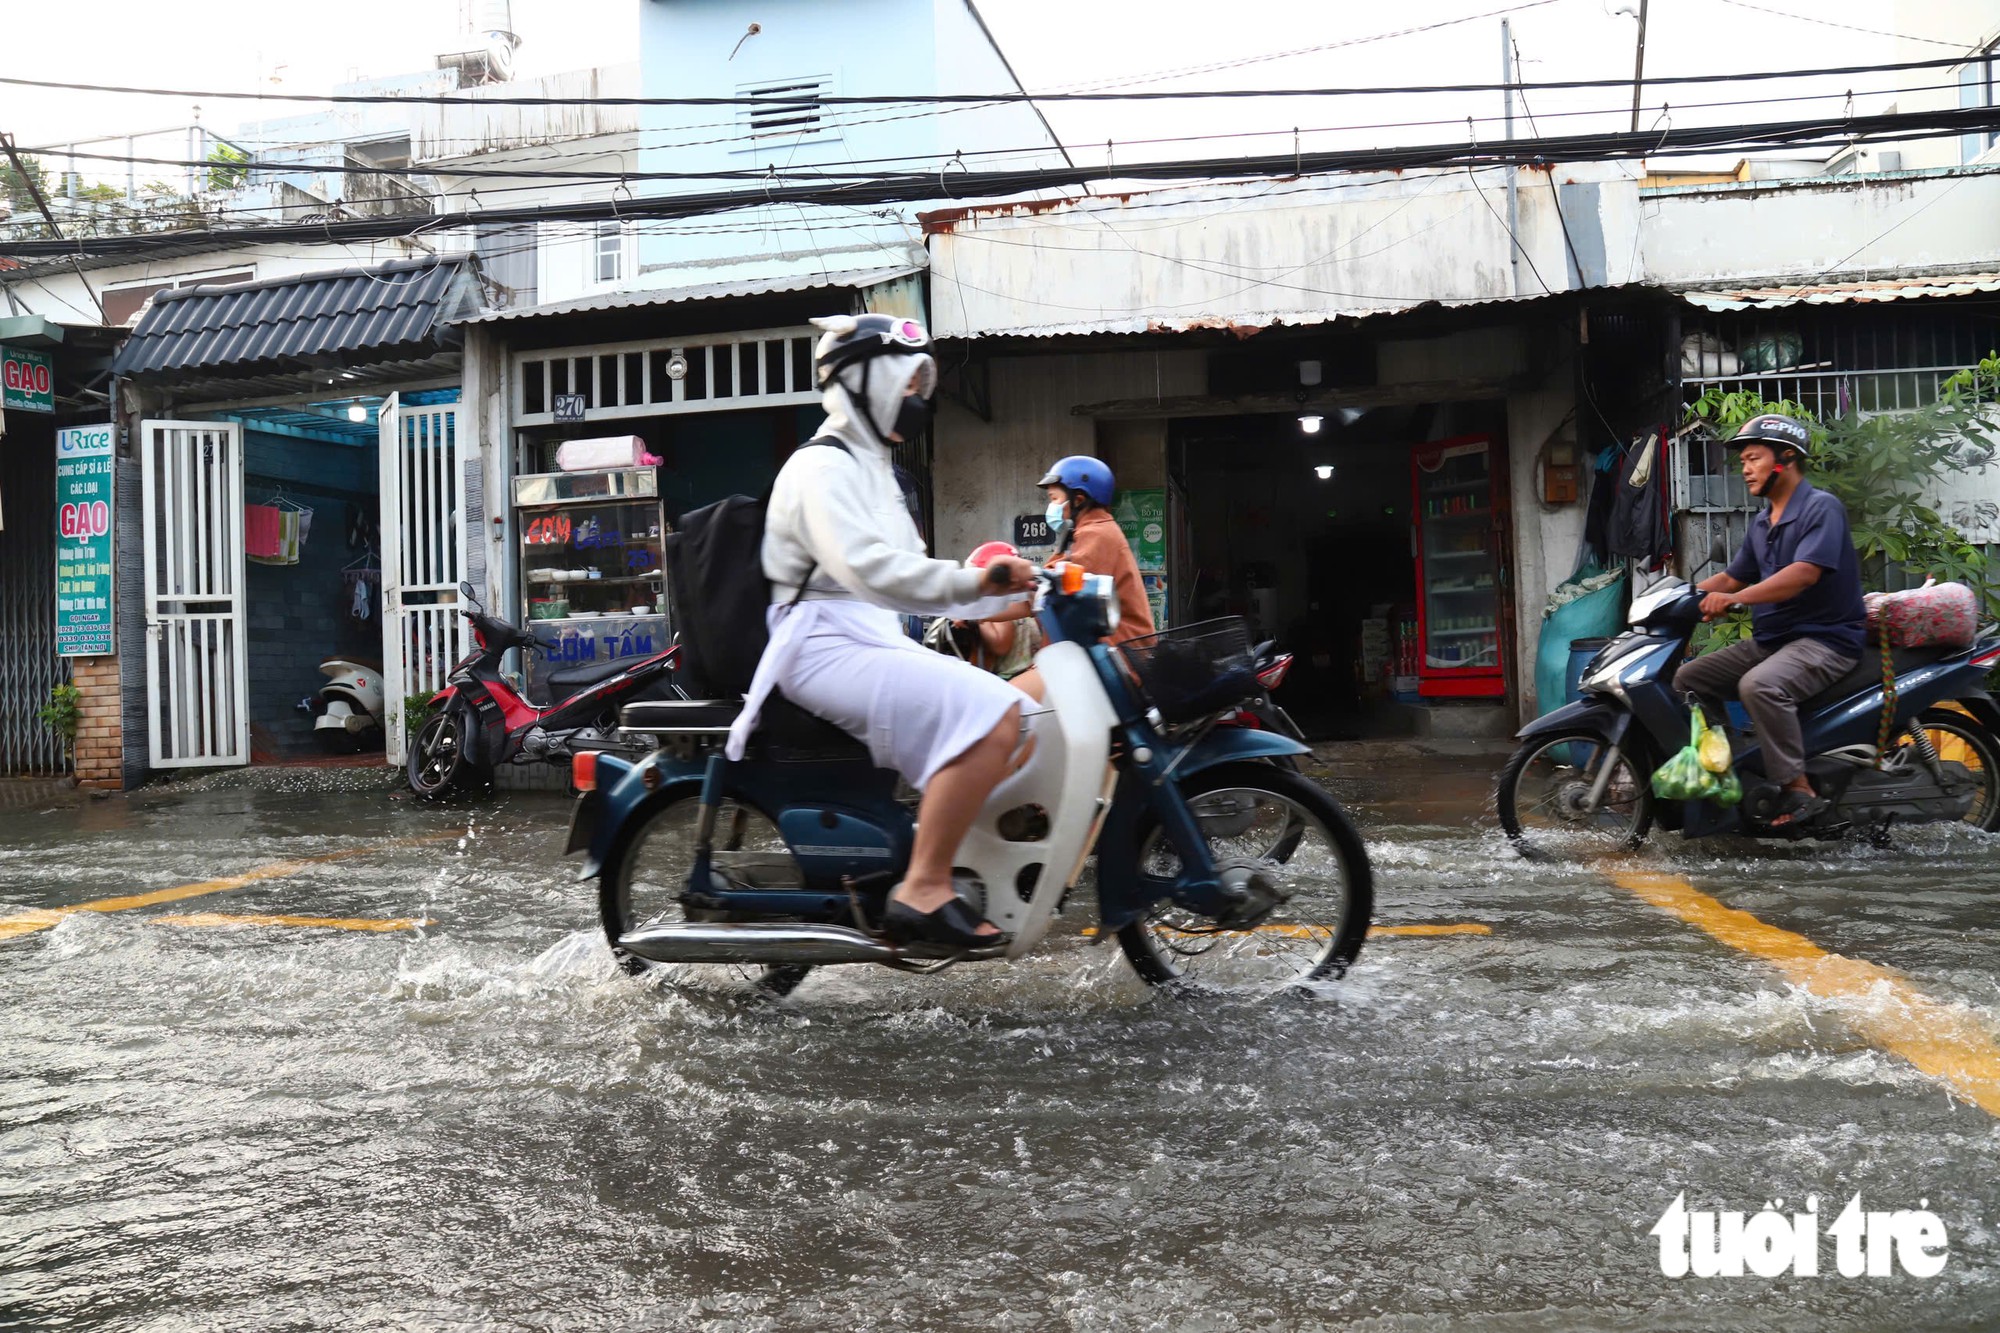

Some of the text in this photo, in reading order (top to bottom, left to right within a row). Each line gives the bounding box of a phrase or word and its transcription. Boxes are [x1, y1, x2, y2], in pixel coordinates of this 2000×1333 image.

[4, 360, 50, 398] GẠO
[556, 397, 584, 416] 270
[62, 430, 109, 451] URice
[58, 465, 74, 476] CUNG
[75, 460, 87, 475] CẤP
[97, 462, 102, 472] &
[71, 481, 98, 496] CÁC LOẠI
[60, 500, 108, 544] GẠO
[527, 515, 571, 545] CƠM
[1022, 521, 1047, 538] 268
[82, 614, 99, 622] NGAY
[547, 622, 652, 662] CƠM TẤM
